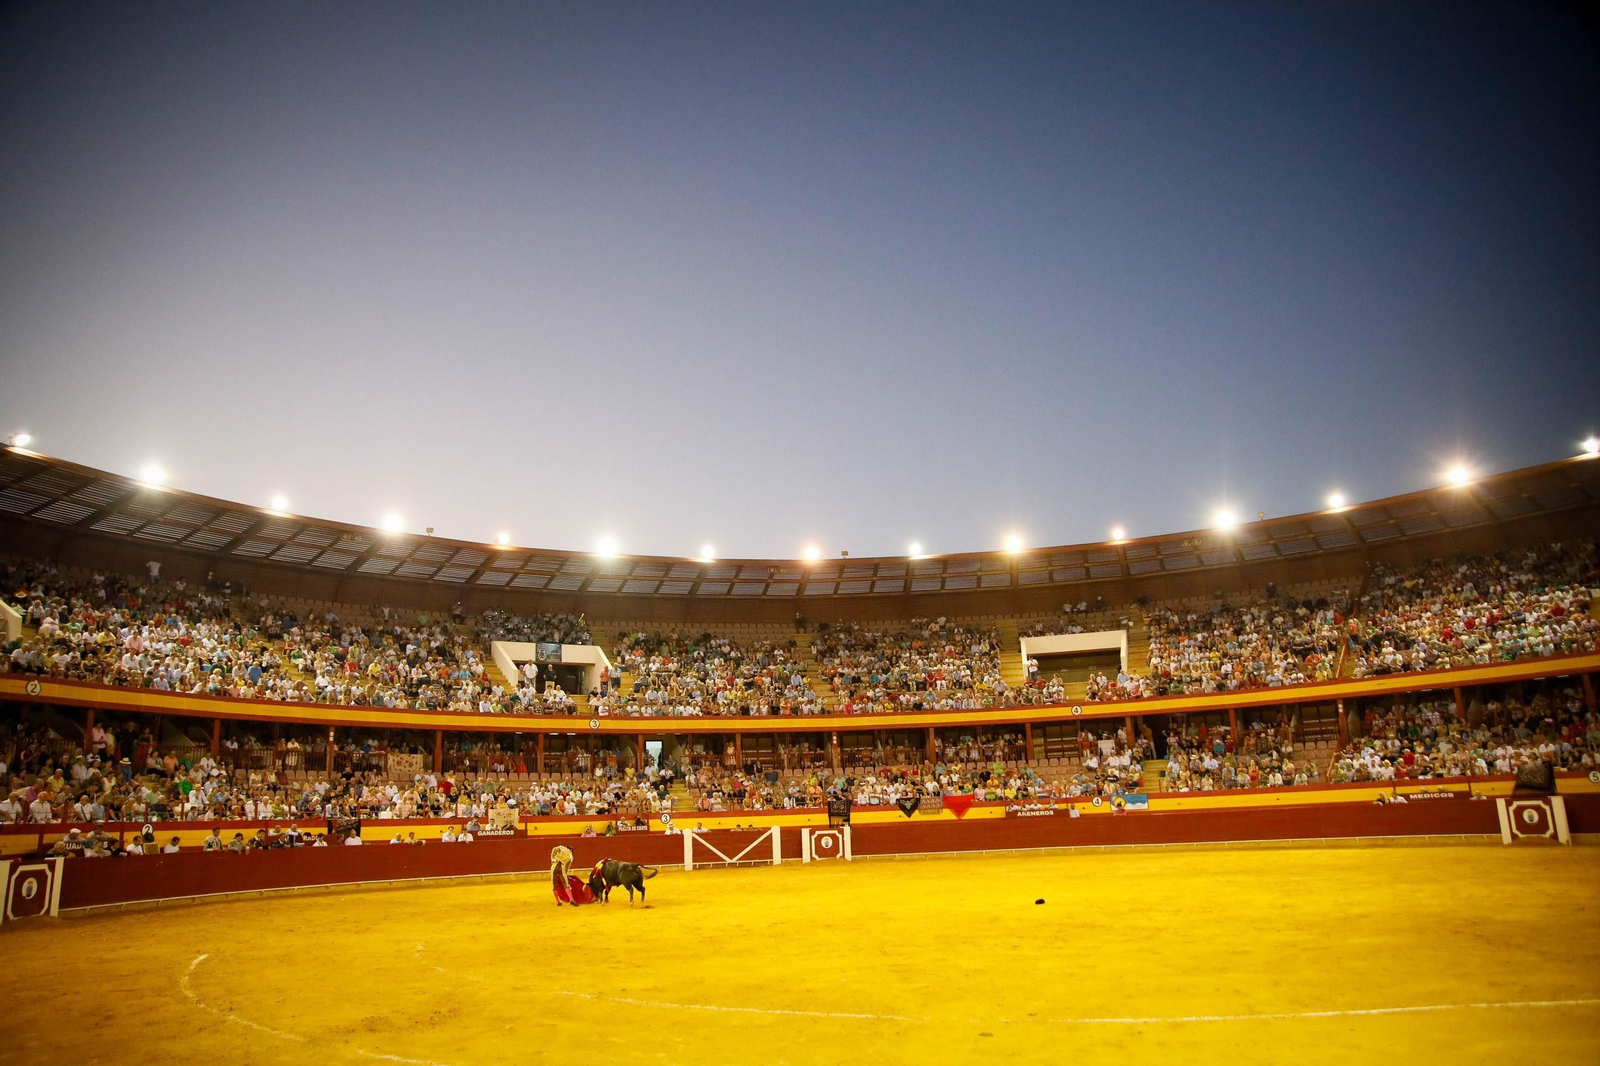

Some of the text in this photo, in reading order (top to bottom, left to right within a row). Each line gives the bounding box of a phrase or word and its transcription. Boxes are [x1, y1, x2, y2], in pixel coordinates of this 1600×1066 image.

[30, 683, 37, 693] 2
[591, 720, 598, 728] 3
[1592, 772, 1599, 781] 5
[662, 815, 669, 823] 3
